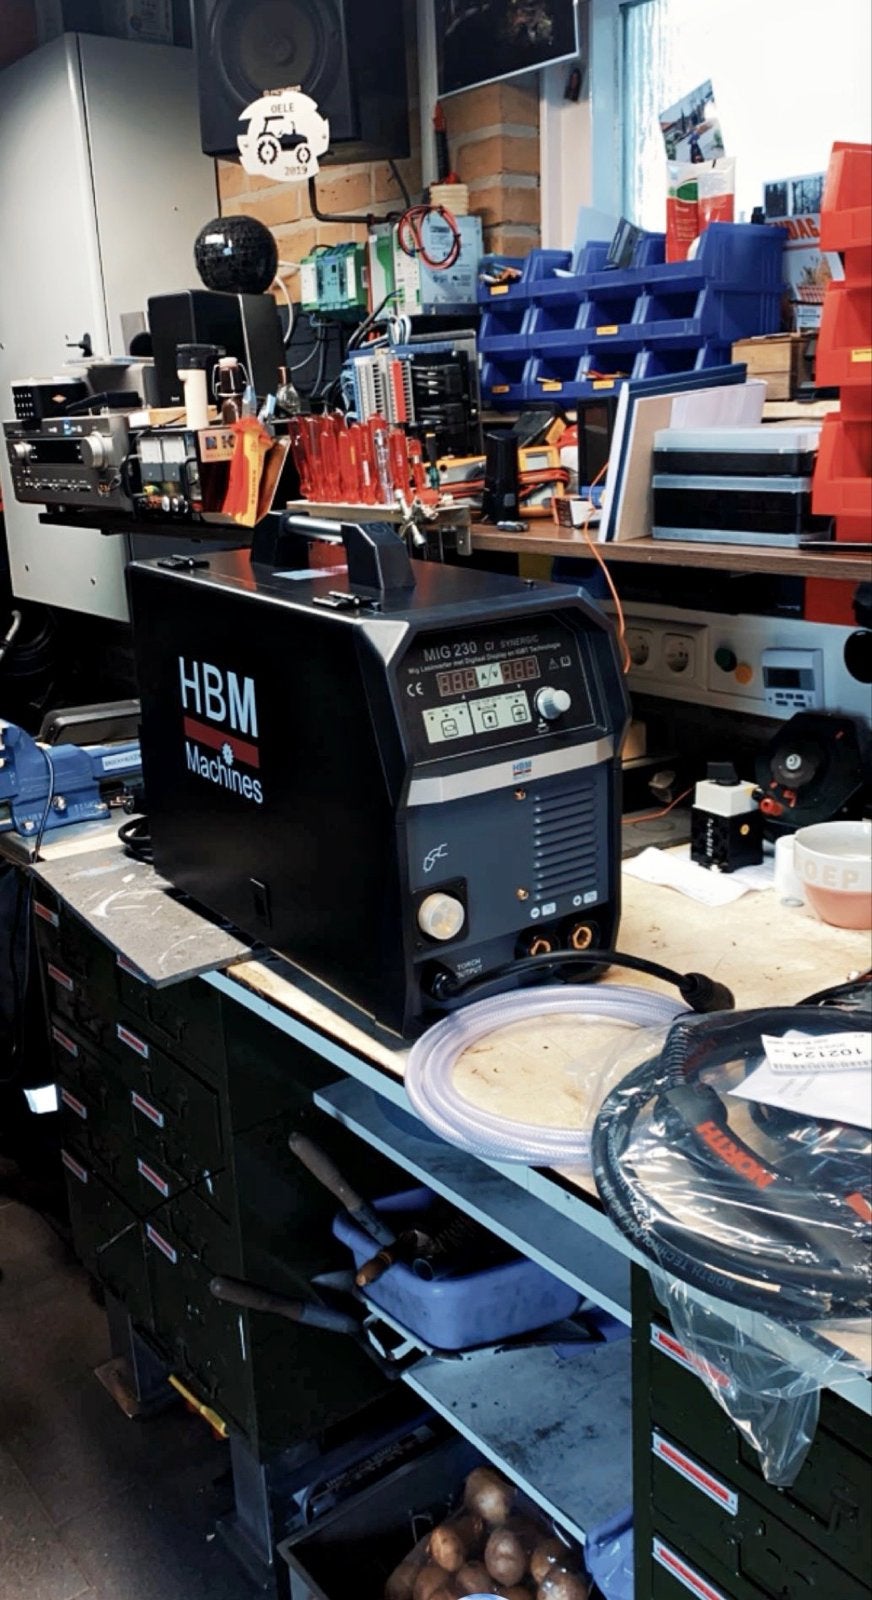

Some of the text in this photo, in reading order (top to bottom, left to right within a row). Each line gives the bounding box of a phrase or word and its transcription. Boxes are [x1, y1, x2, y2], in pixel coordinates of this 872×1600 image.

[270, 103, 295, 113] OELE
[284, 166, 308, 176] 2019
[423, 645, 452, 662] MIG
[453, 641, 478, 658] 230
[178, 656, 259, 738] HBM
[185, 741, 264, 804] Machines
[798, 858, 860, 888] OEP
[792, 1047, 863, 1058] 102124
[695, 1120, 774, 1191] NORTH
[691, 1266, 736, 1291] NORTH
